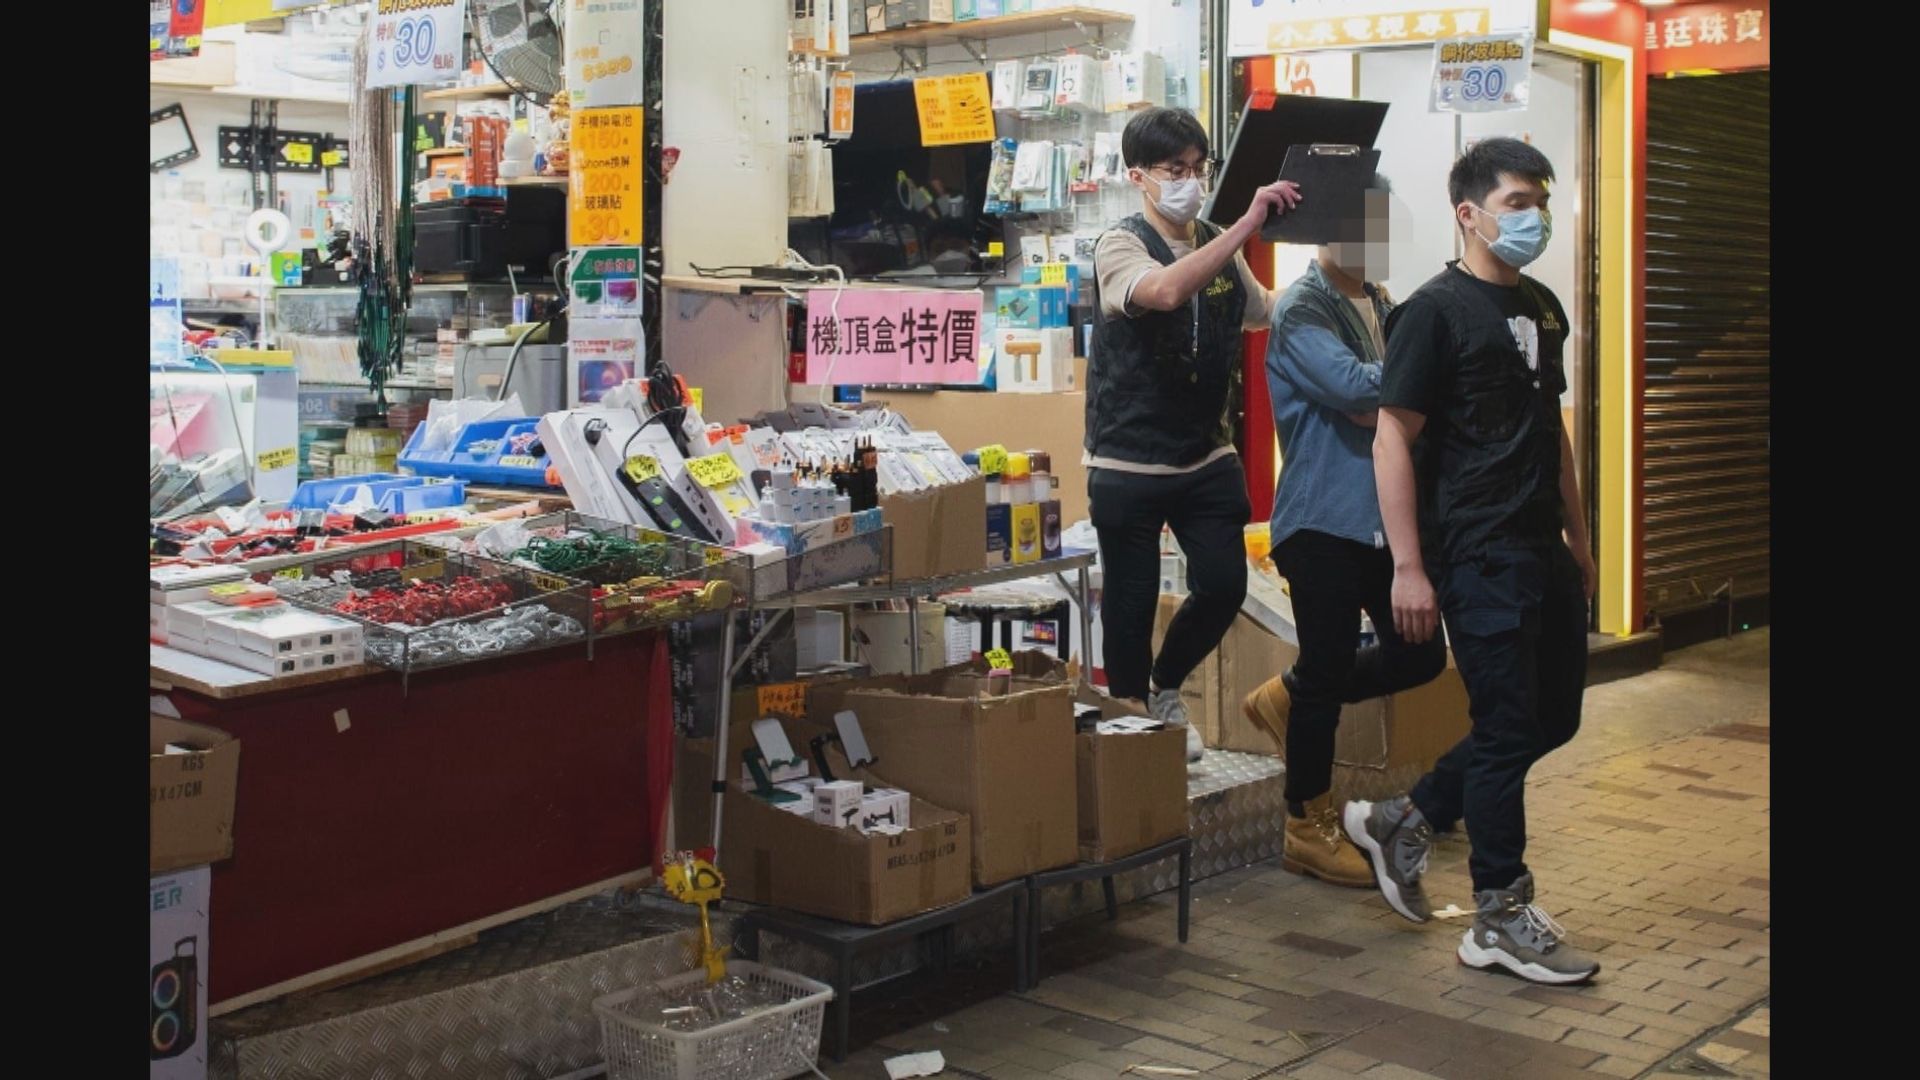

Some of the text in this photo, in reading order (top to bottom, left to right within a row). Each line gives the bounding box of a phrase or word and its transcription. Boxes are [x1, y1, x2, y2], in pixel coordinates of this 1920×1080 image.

[393, 14, 436, 68] 30
[1461, 64, 1507, 101] 30
[182, 755, 206, 772] KGS
